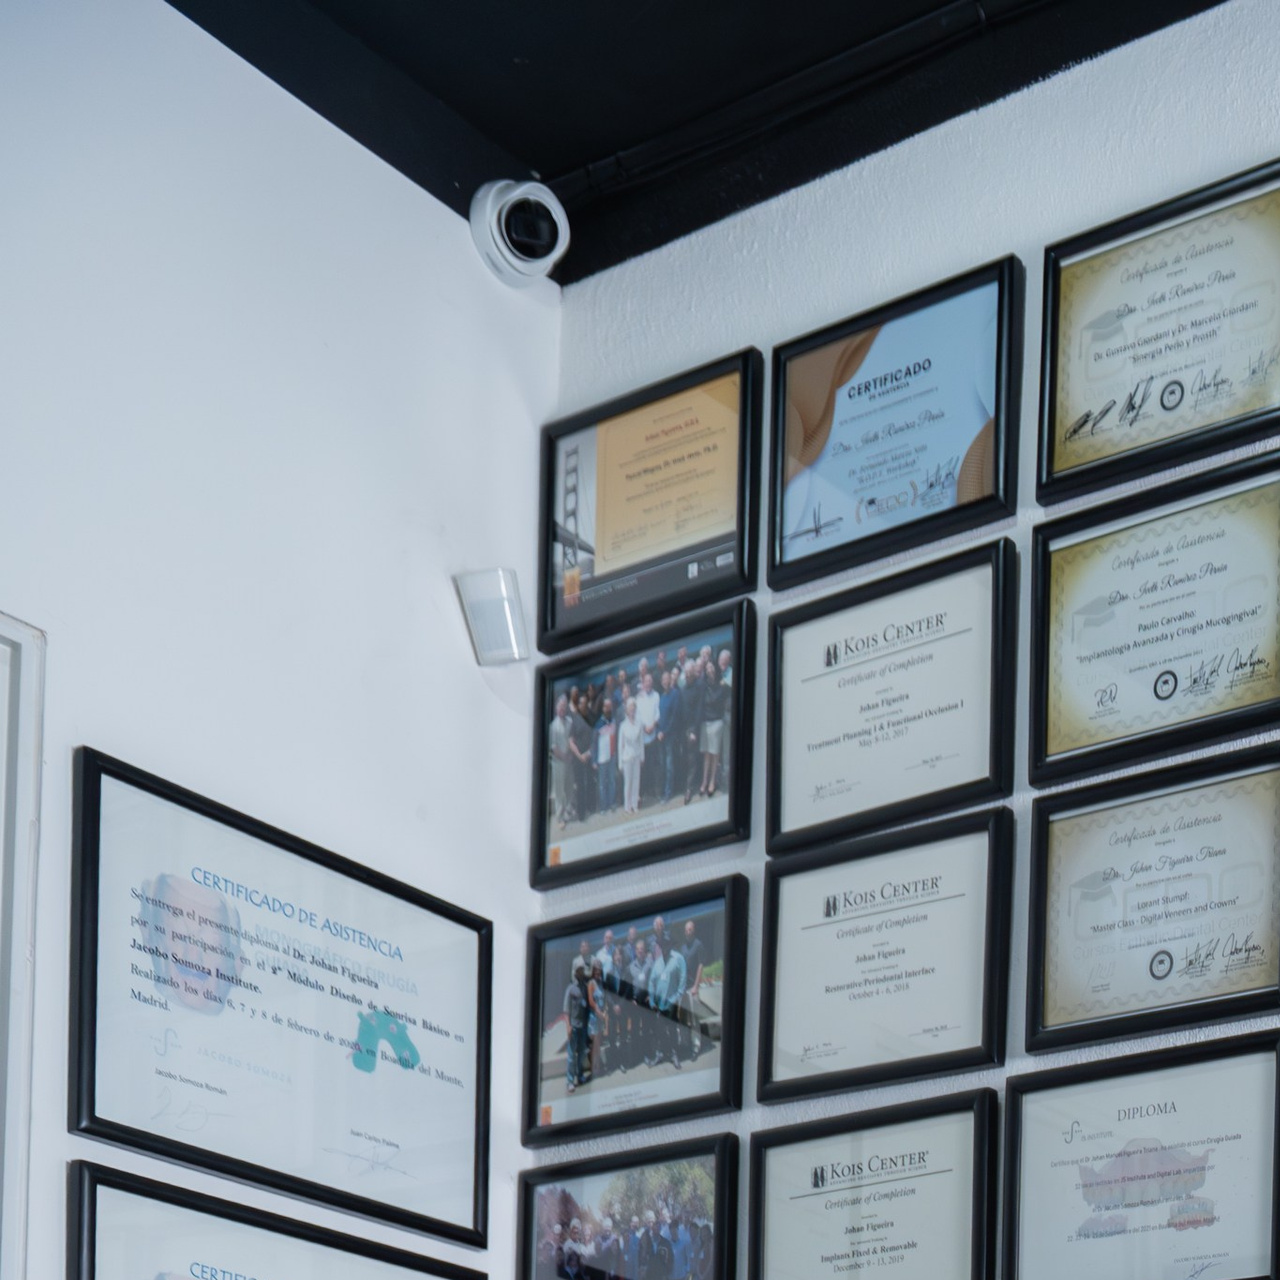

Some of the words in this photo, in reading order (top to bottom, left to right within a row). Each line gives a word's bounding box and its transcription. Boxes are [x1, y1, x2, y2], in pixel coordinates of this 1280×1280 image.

[848, 358, 932, 399] CERTIFICADO
[191, 866, 295, 920] CERTIFICADO
[299, 908, 318, 928] DE
[320, 916, 403, 962] ASISTENCIA
[1117, 1101, 1177, 1121] DIPLOMA
